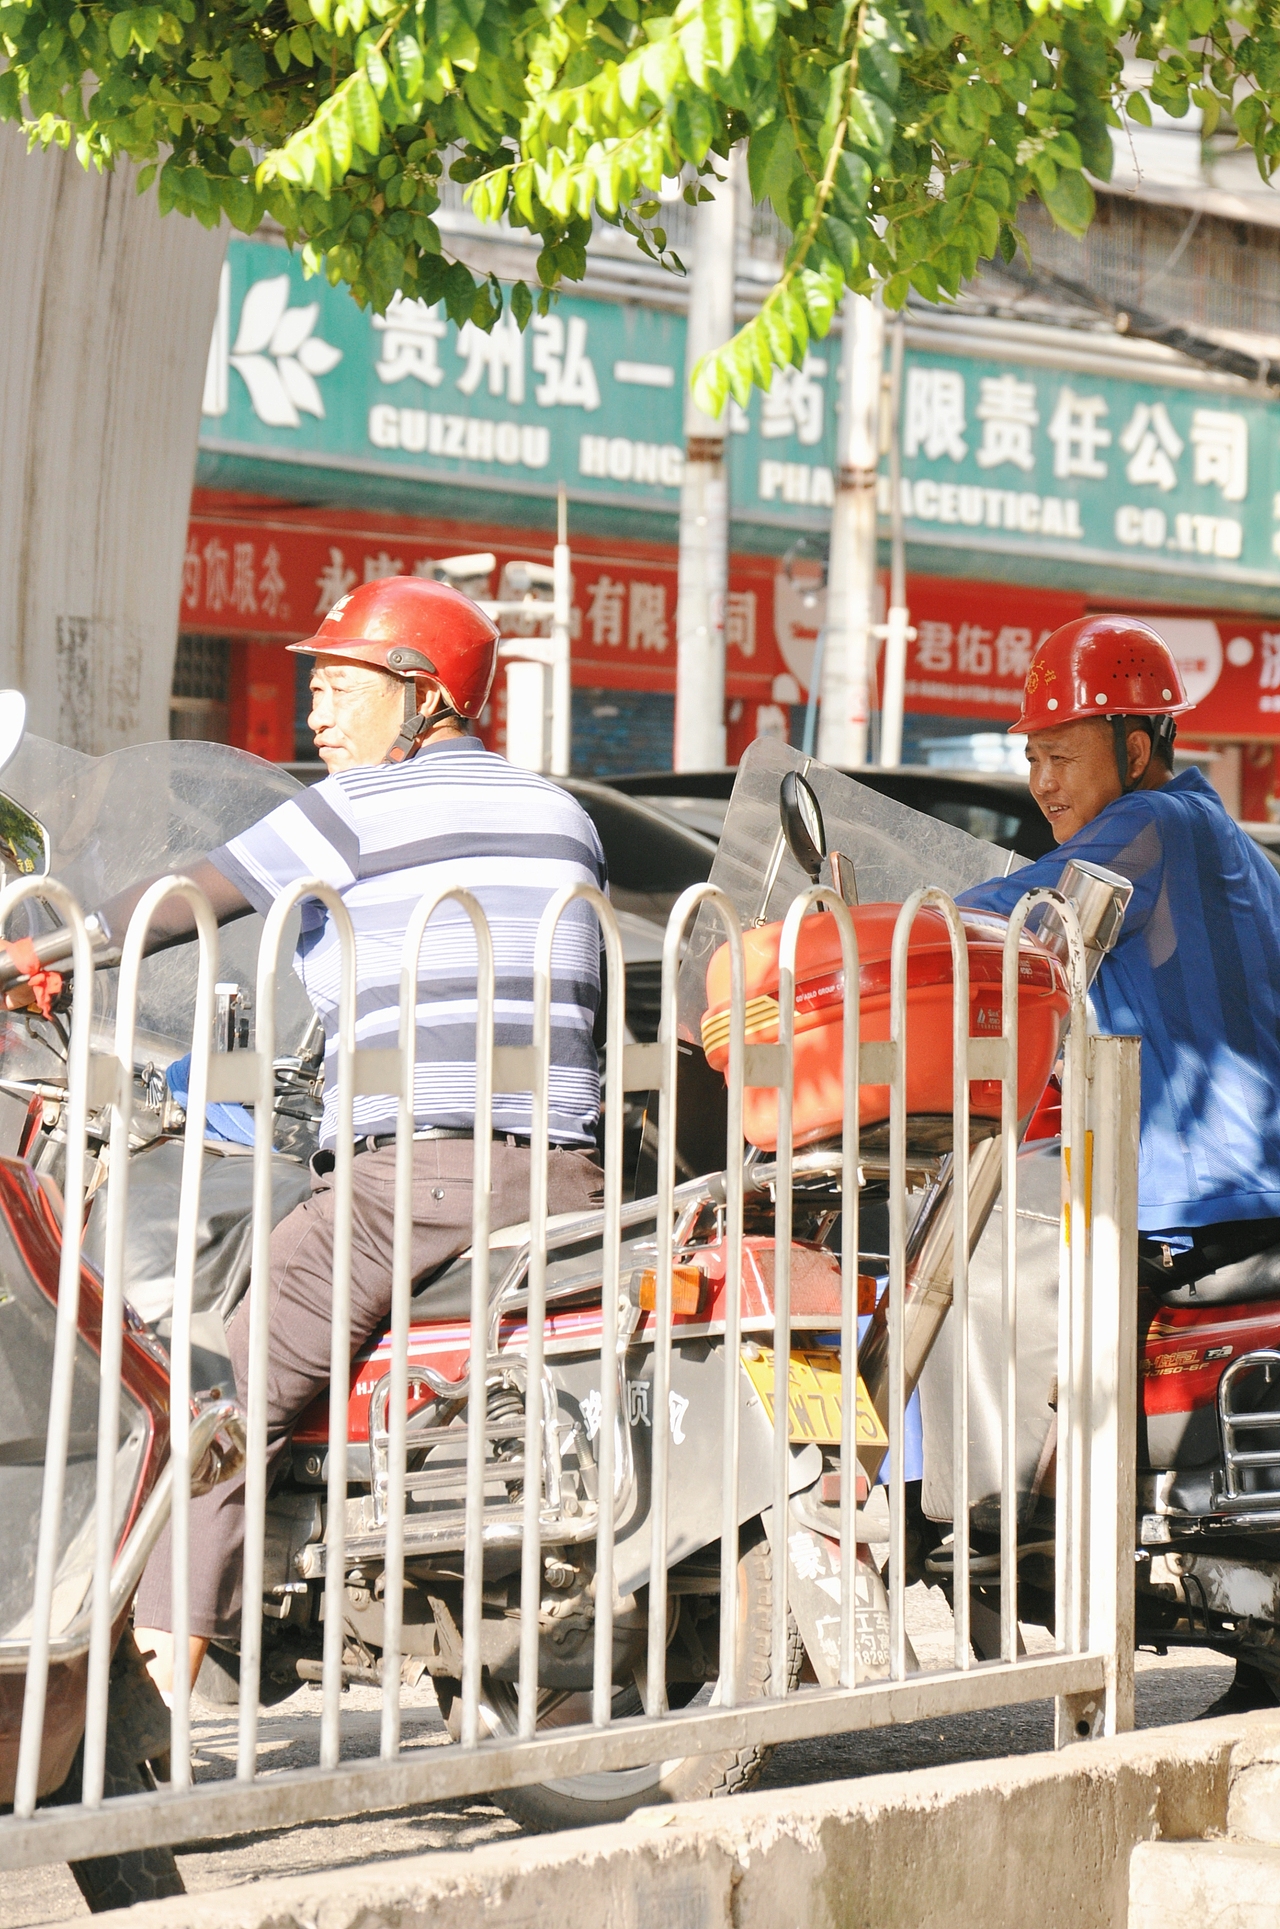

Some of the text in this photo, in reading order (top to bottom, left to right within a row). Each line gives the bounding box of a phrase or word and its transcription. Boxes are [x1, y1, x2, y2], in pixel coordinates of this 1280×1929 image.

[370, 289, 1250, 501] 贵州弘一药限责任公司
[367, 402, 551, 470] GUIZHOU
[757, 458, 1084, 539] PHAACEUTICAL
[915, 618, 1052, 679] 君佑保
